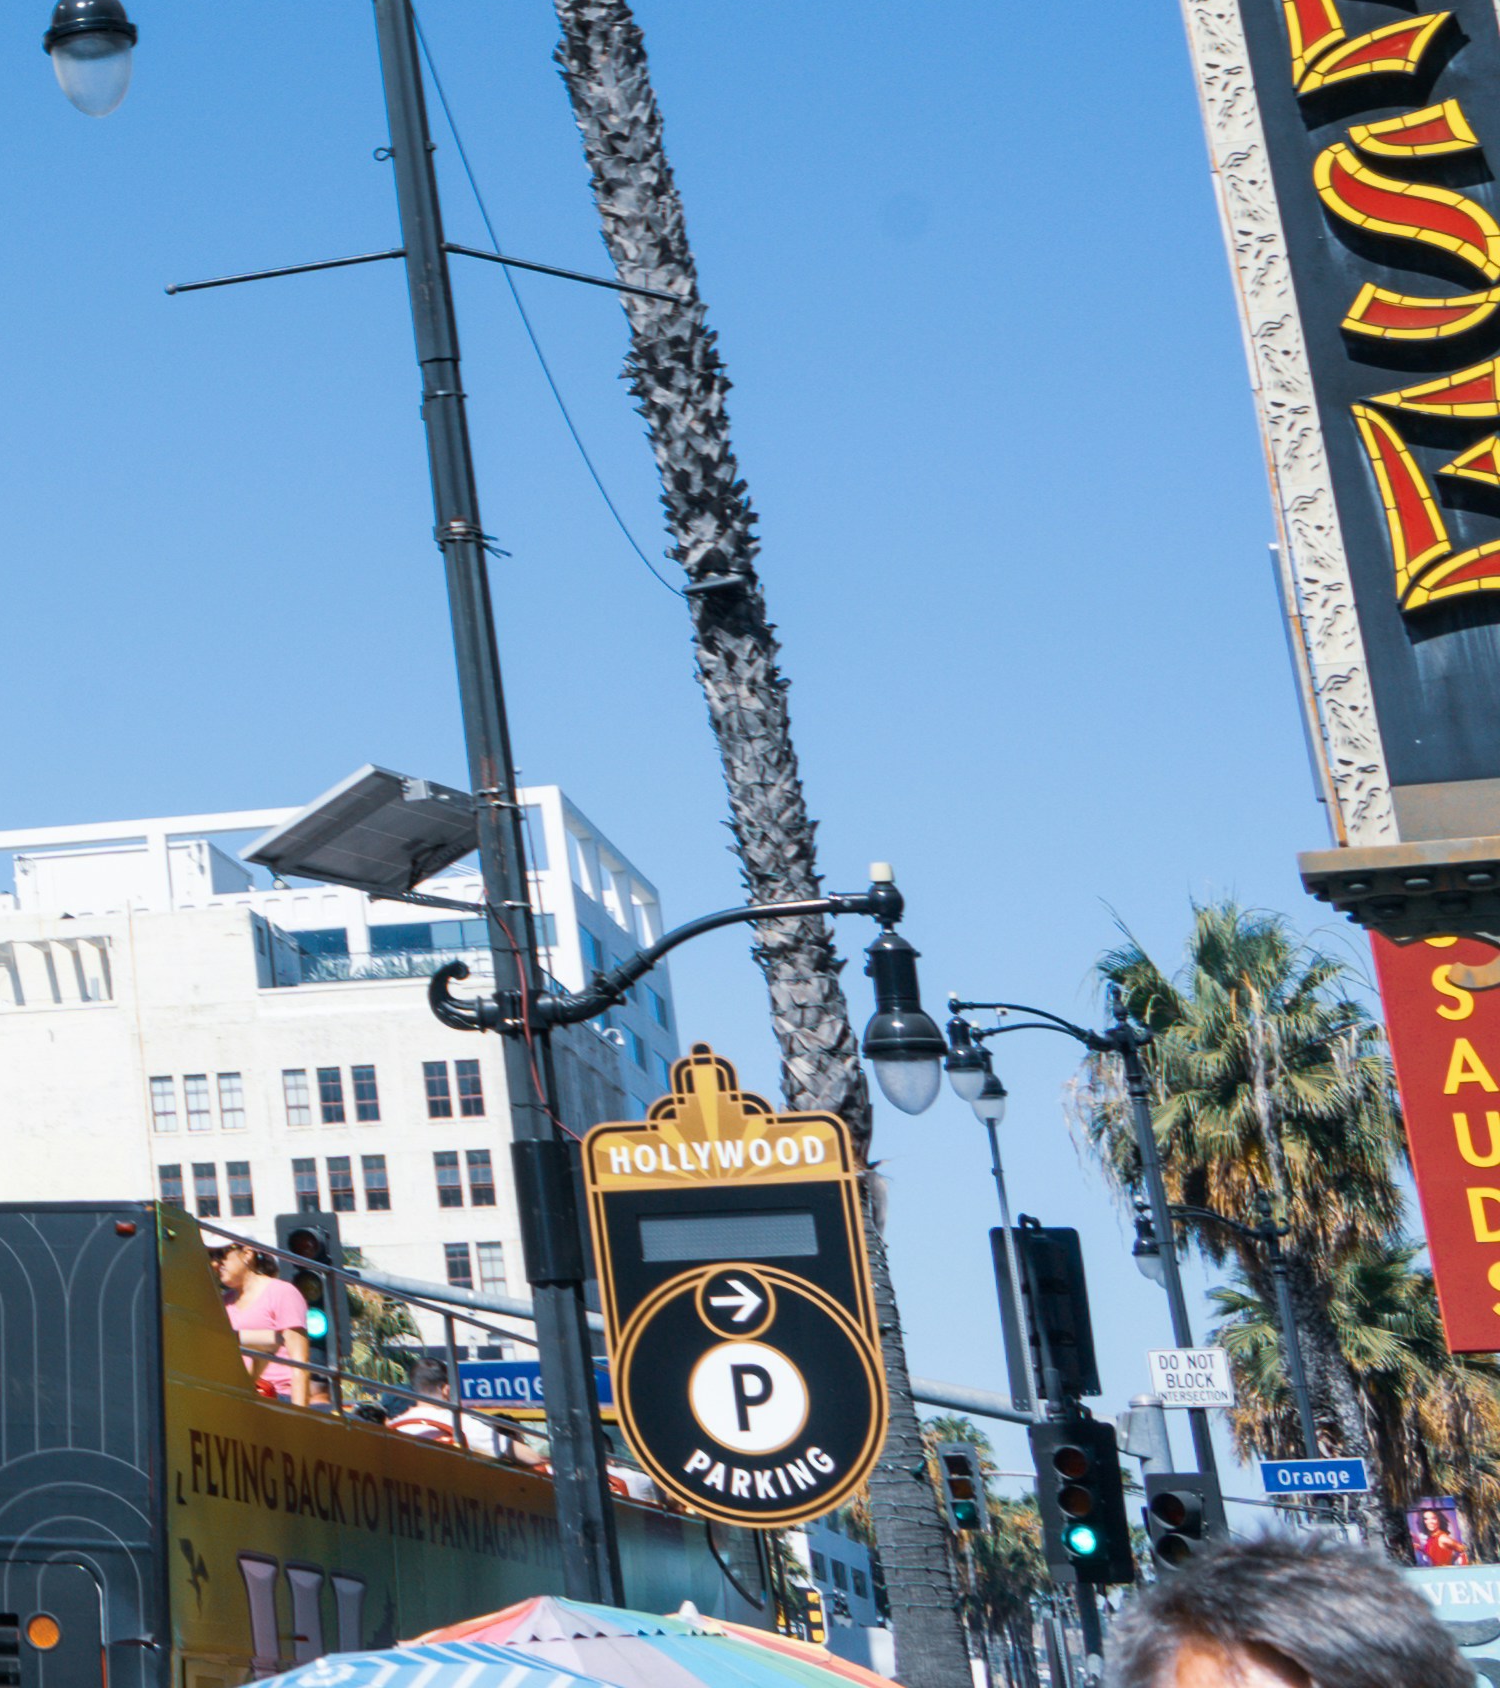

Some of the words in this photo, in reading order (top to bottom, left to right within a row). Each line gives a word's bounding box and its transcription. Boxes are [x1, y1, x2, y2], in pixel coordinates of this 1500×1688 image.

[1424, 936, 1500, 1316] SAUD
[610, 1135, 826, 1176] HOLLYWOOD
[1159, 1354, 1179, 1369] DO
[1187, 1354, 1214, 1369] NOT
[1166, 1373, 1215, 1388] BLOCK
[730, 1362, 773, 1432] P
[683, 1446, 834, 1501] PARKING
[1277, 1469, 1350, 1489] Orange
[188, 1429, 278, 1512] FLYING
[282, 1451, 348, 1525] BACK
[348, 1469, 379, 1533] TO
[382, 1477, 425, 1541] THE
[428, 1487, 529, 1565] PANTAGES
[1422, 1579, 1500, 1605] VEN
